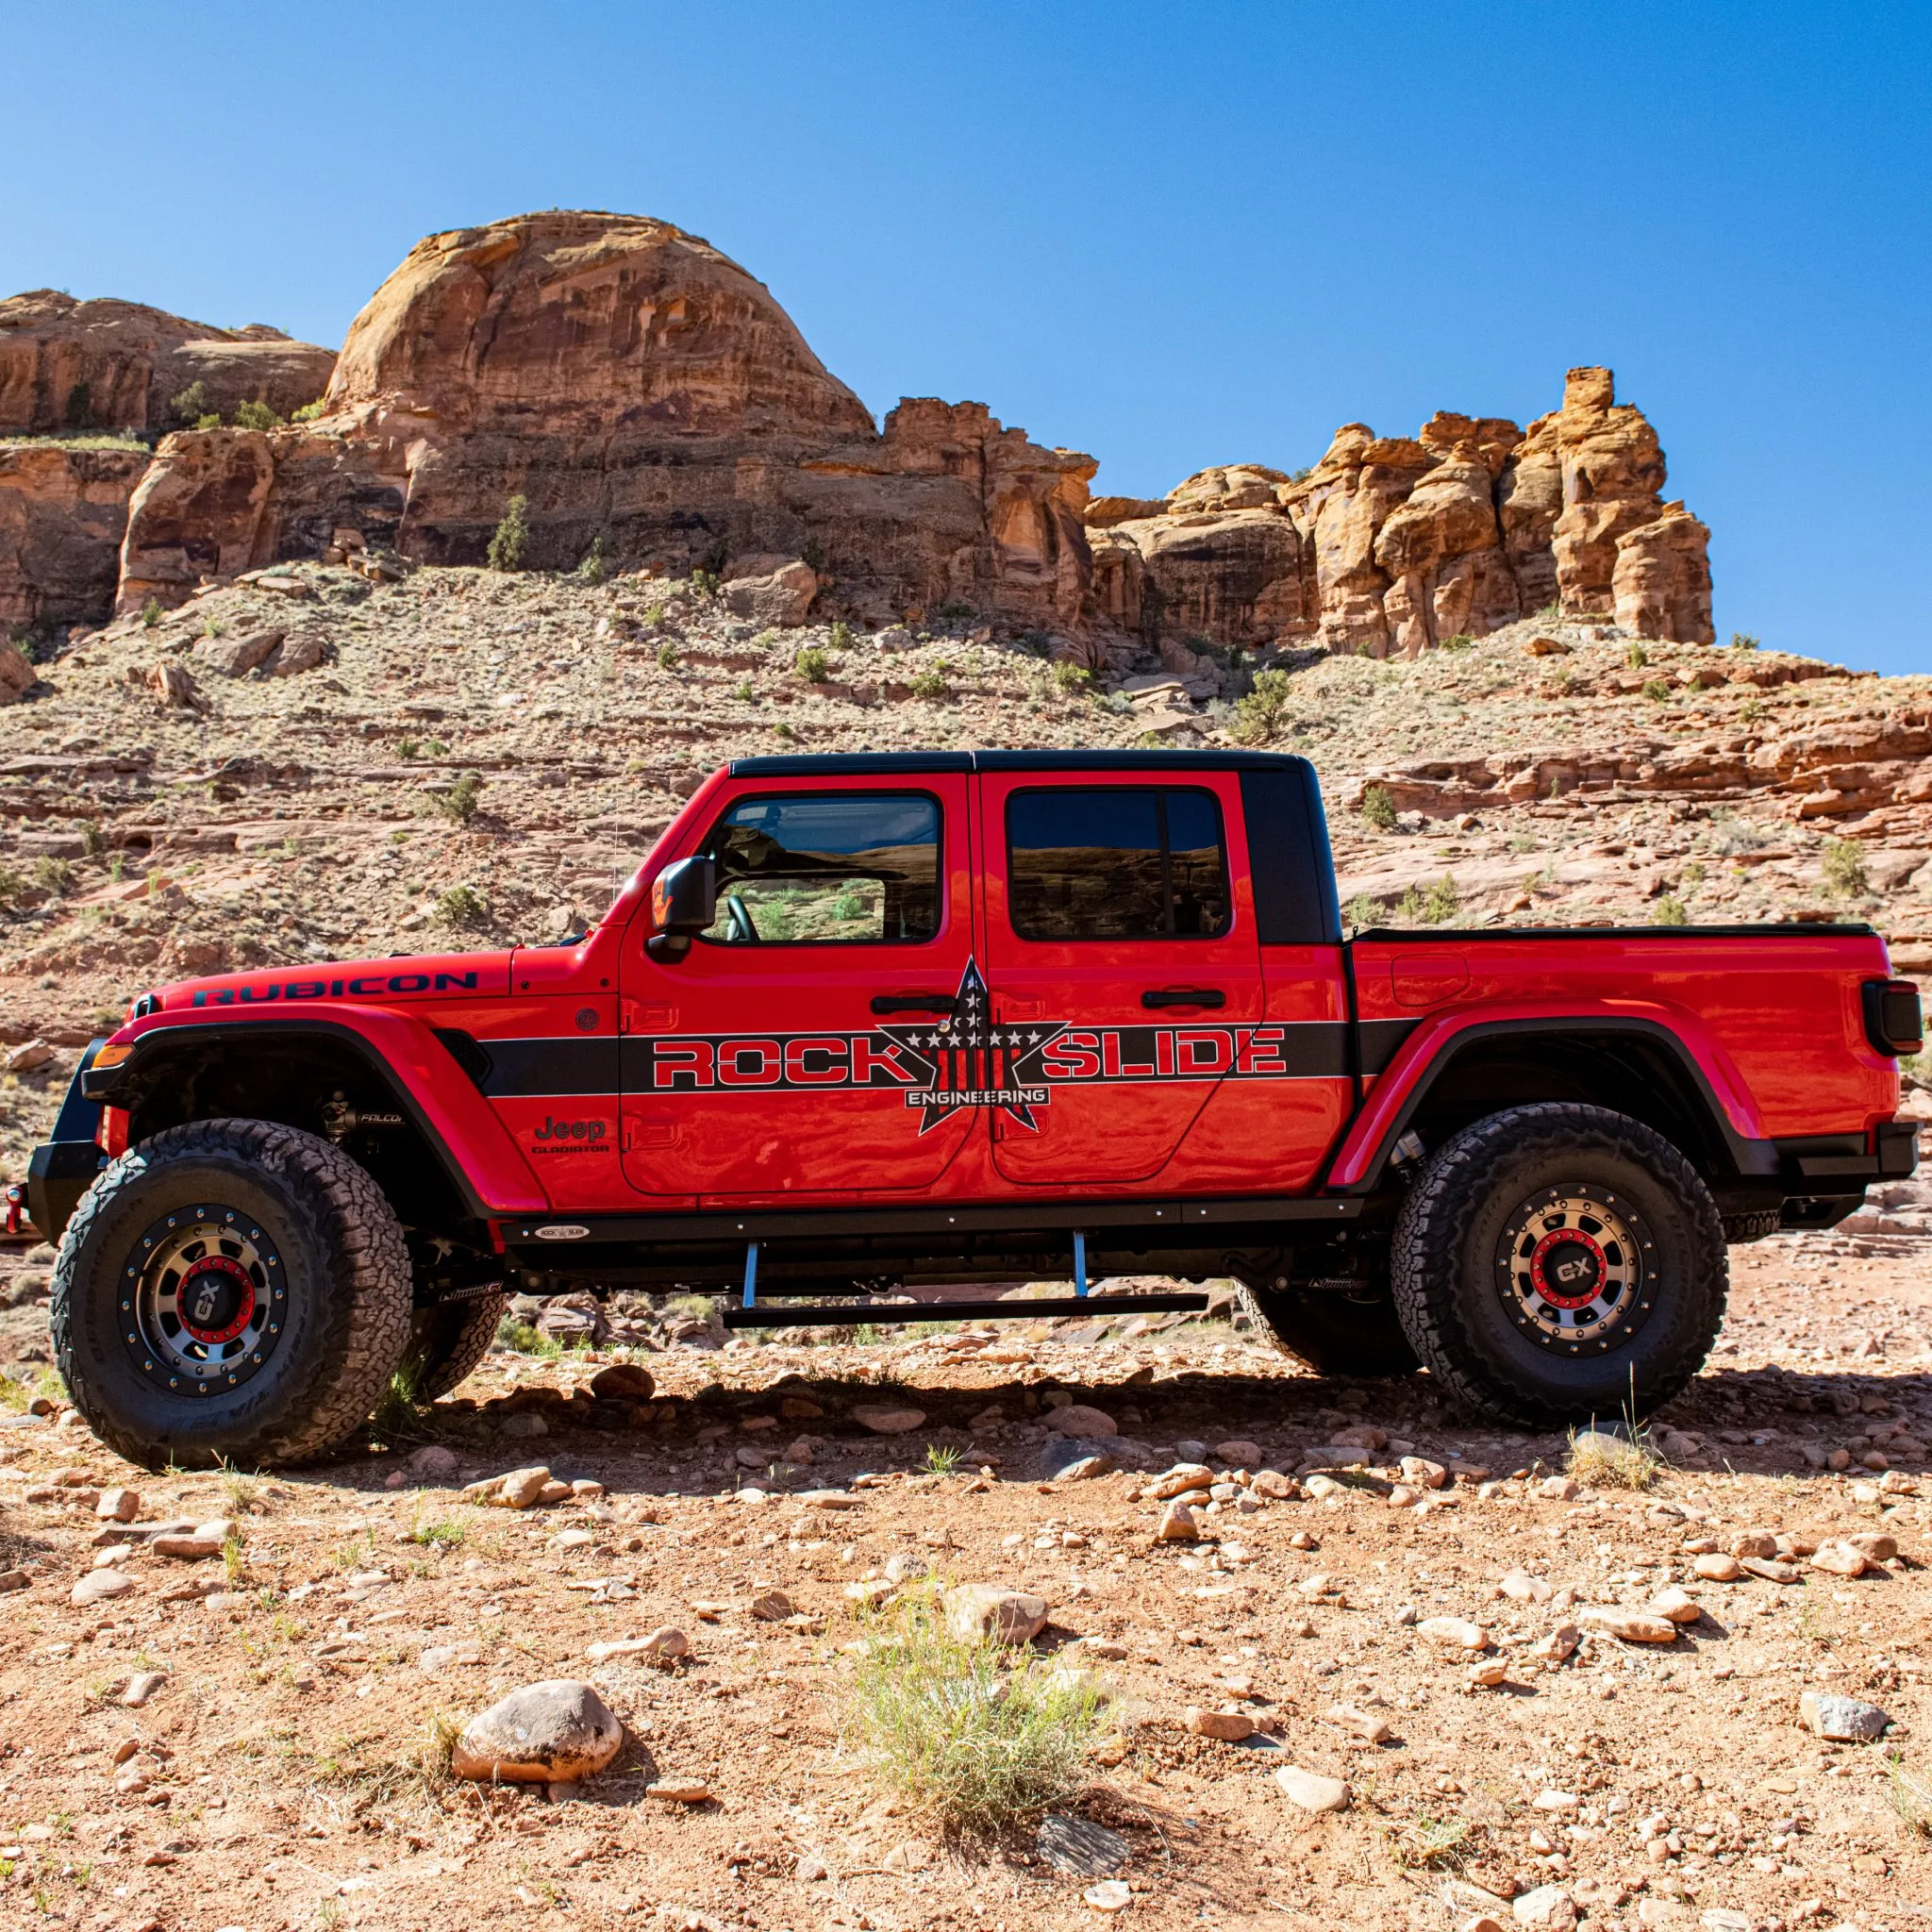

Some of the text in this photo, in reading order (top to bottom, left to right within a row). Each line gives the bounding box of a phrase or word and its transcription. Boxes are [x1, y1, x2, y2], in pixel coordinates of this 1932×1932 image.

[192, 972, 478, 1008] RUBICON
[653, 1028, 1287, 1088] ROCK SLIDE
[908, 1090, 1045, 1105] ENGINEERING
[535, 1116, 606, 1142] Jeep
[531, 1145, 610, 1154] GLADIATOR
